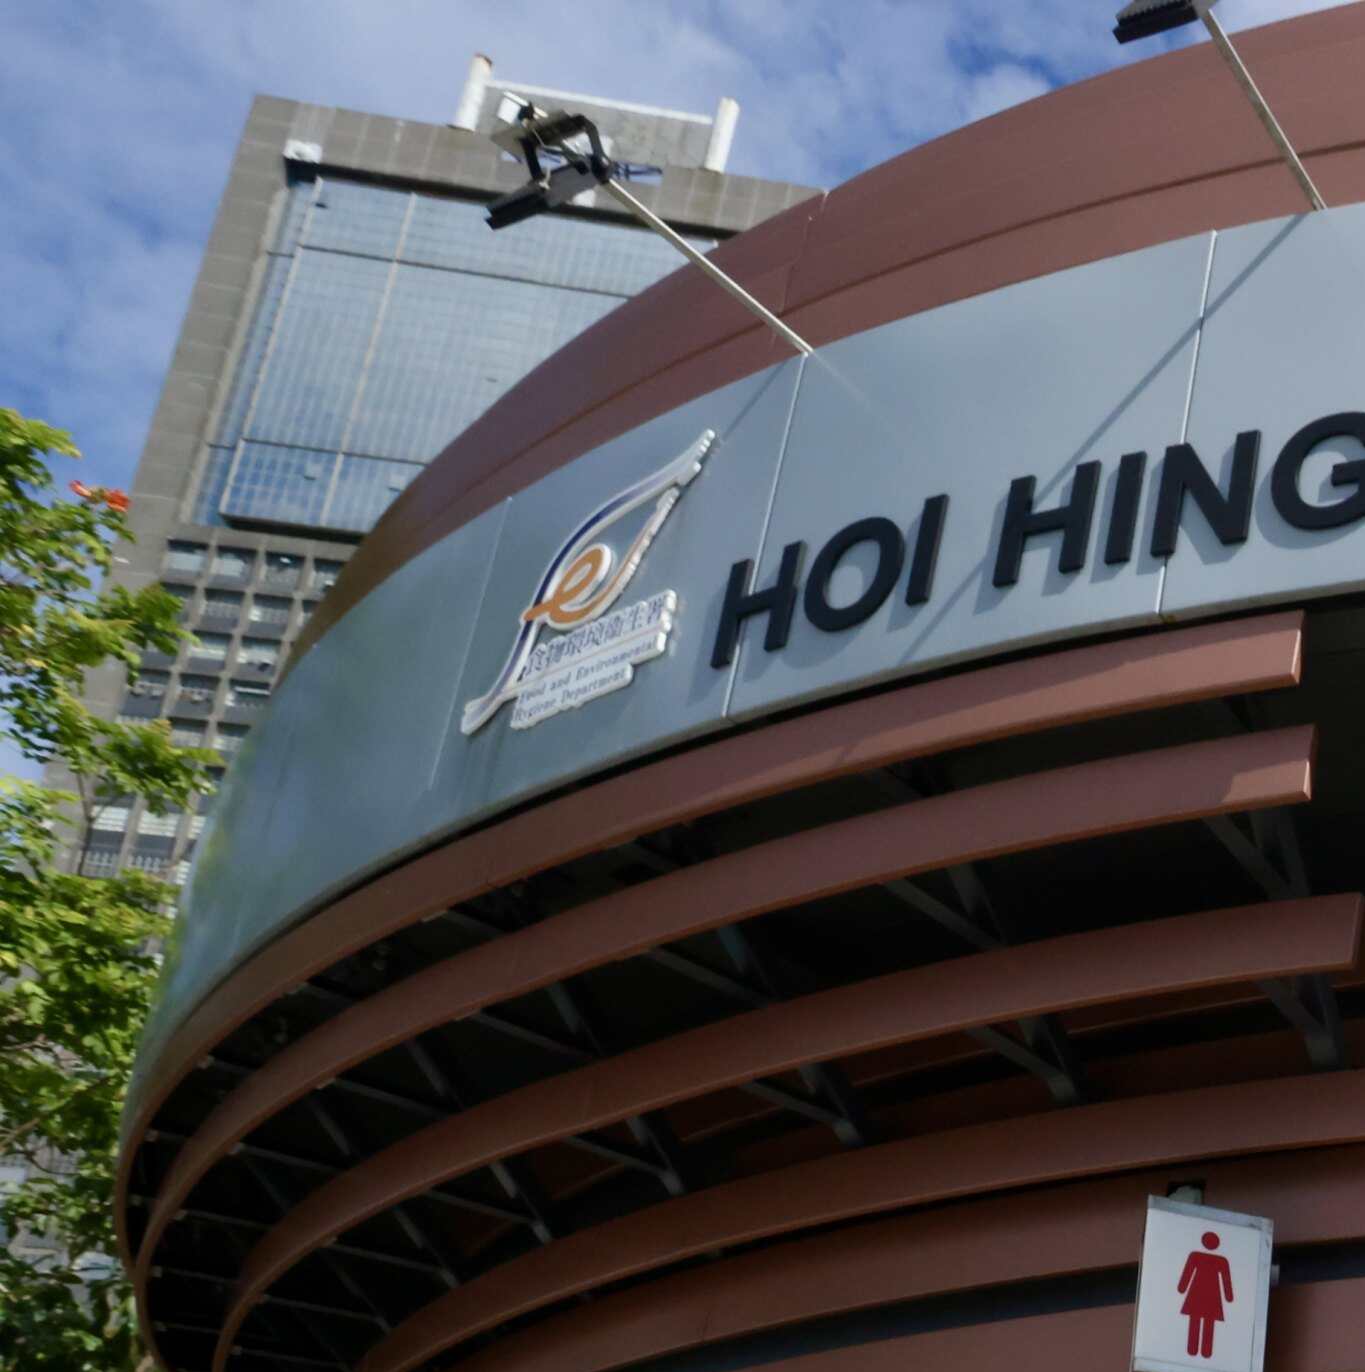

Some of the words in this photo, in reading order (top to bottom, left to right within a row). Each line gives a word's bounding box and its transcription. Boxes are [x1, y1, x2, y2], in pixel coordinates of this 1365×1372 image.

[710, 493, 950, 670] HOI
[519, 683, 546, 704] Food
[550, 673, 572, 691] and
[576, 638, 656, 678] Environmental
[561, 669, 627, 704] Department
